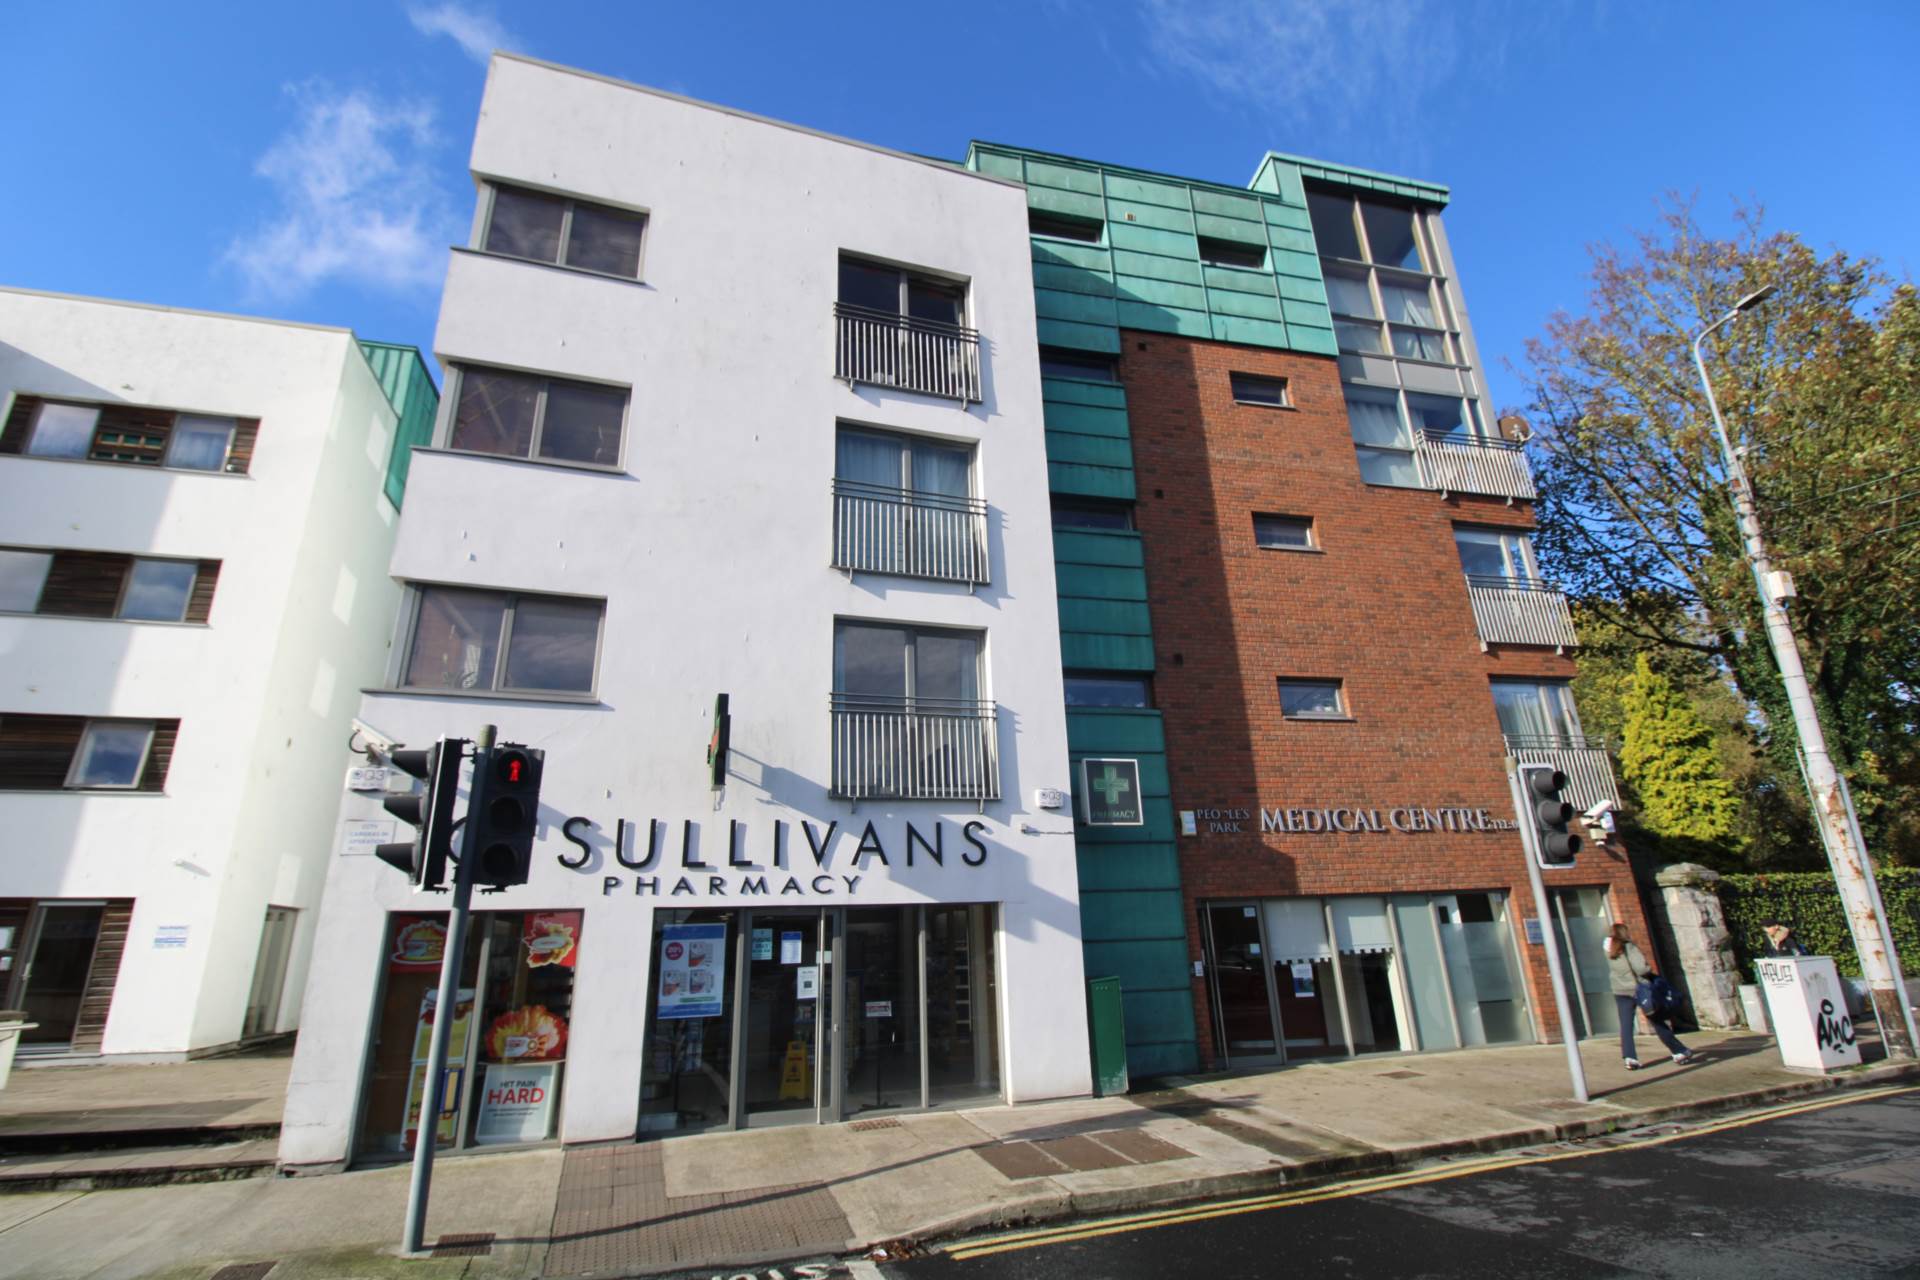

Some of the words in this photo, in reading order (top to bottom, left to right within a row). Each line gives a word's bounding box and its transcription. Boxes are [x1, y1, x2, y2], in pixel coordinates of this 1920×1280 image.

[1210, 821, 1241, 833] PARK
[1261, 807, 1386, 832] MEDICAL
[1390, 806, 1491, 832] CENTRE
[603, 875, 860, 896] PHARMACY
[487, 1087, 545, 1105] HARD
